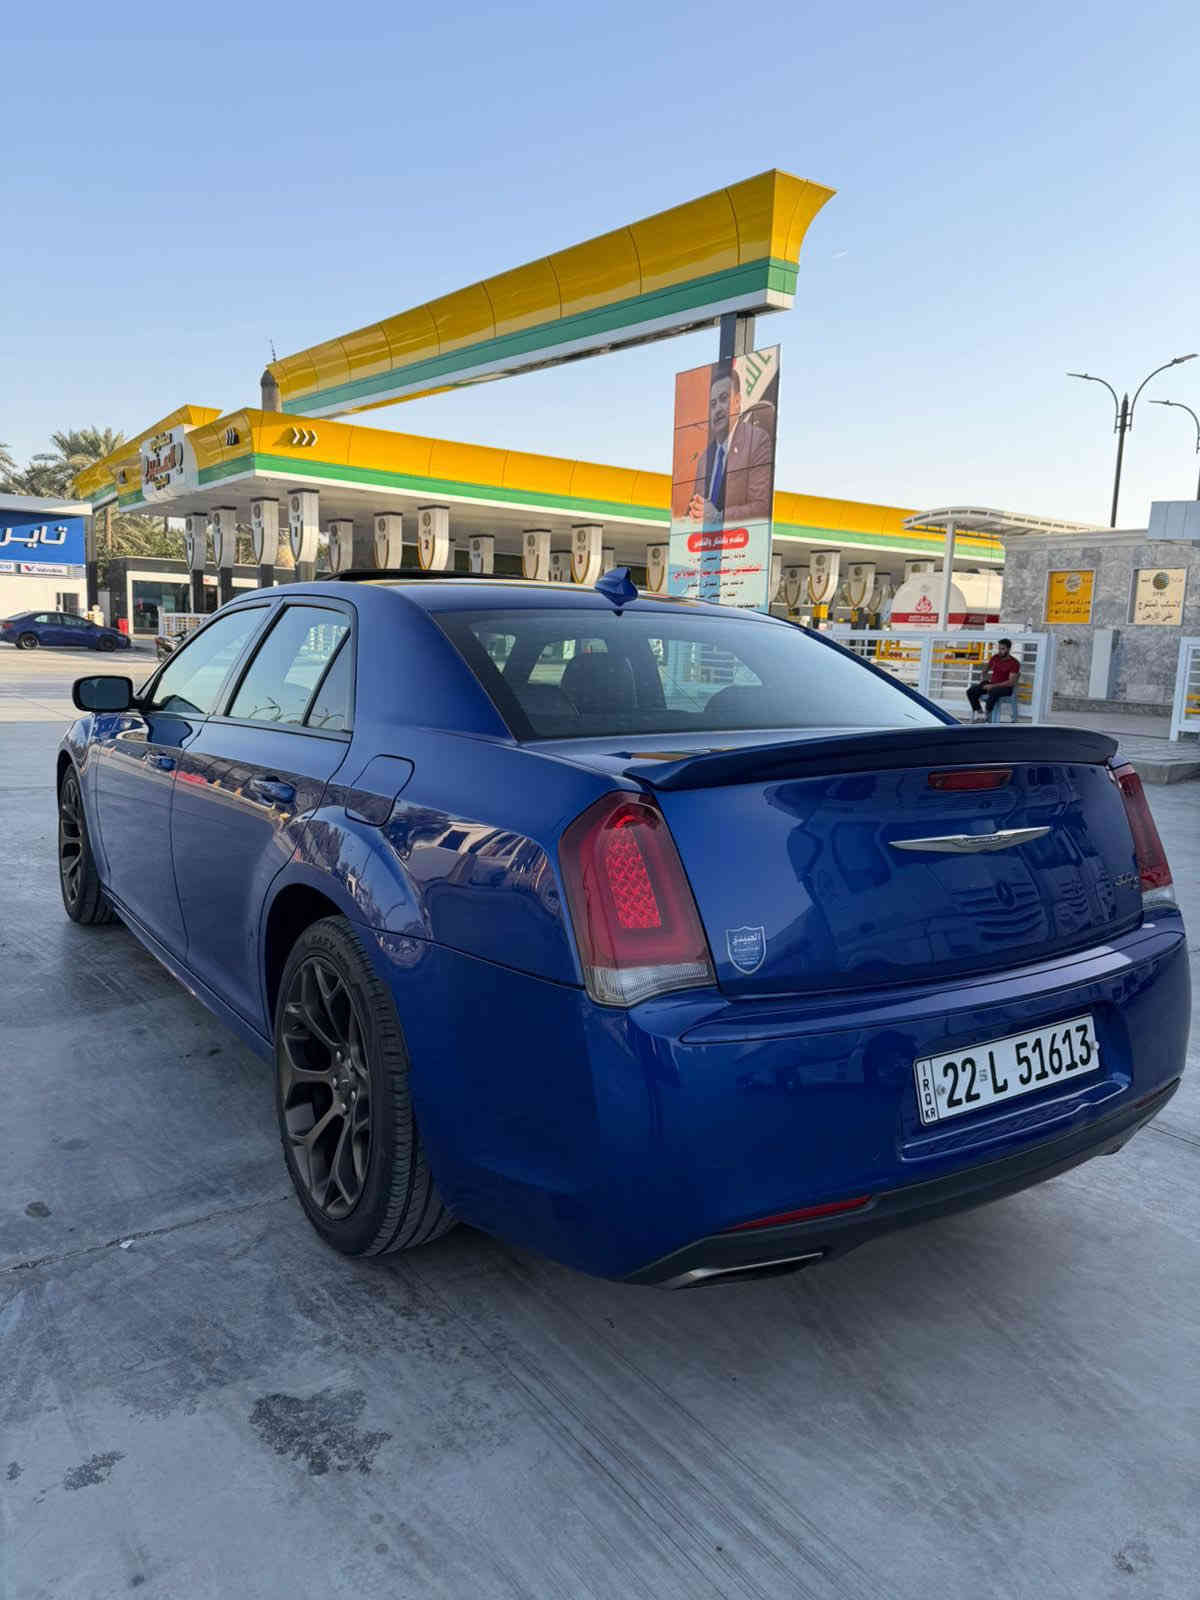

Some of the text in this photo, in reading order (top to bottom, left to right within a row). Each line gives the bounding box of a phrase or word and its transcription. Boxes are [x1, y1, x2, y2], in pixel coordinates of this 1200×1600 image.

[942, 1024, 1092, 1109] 22 L 51613
[924, 1106, 937, 1120] KR
